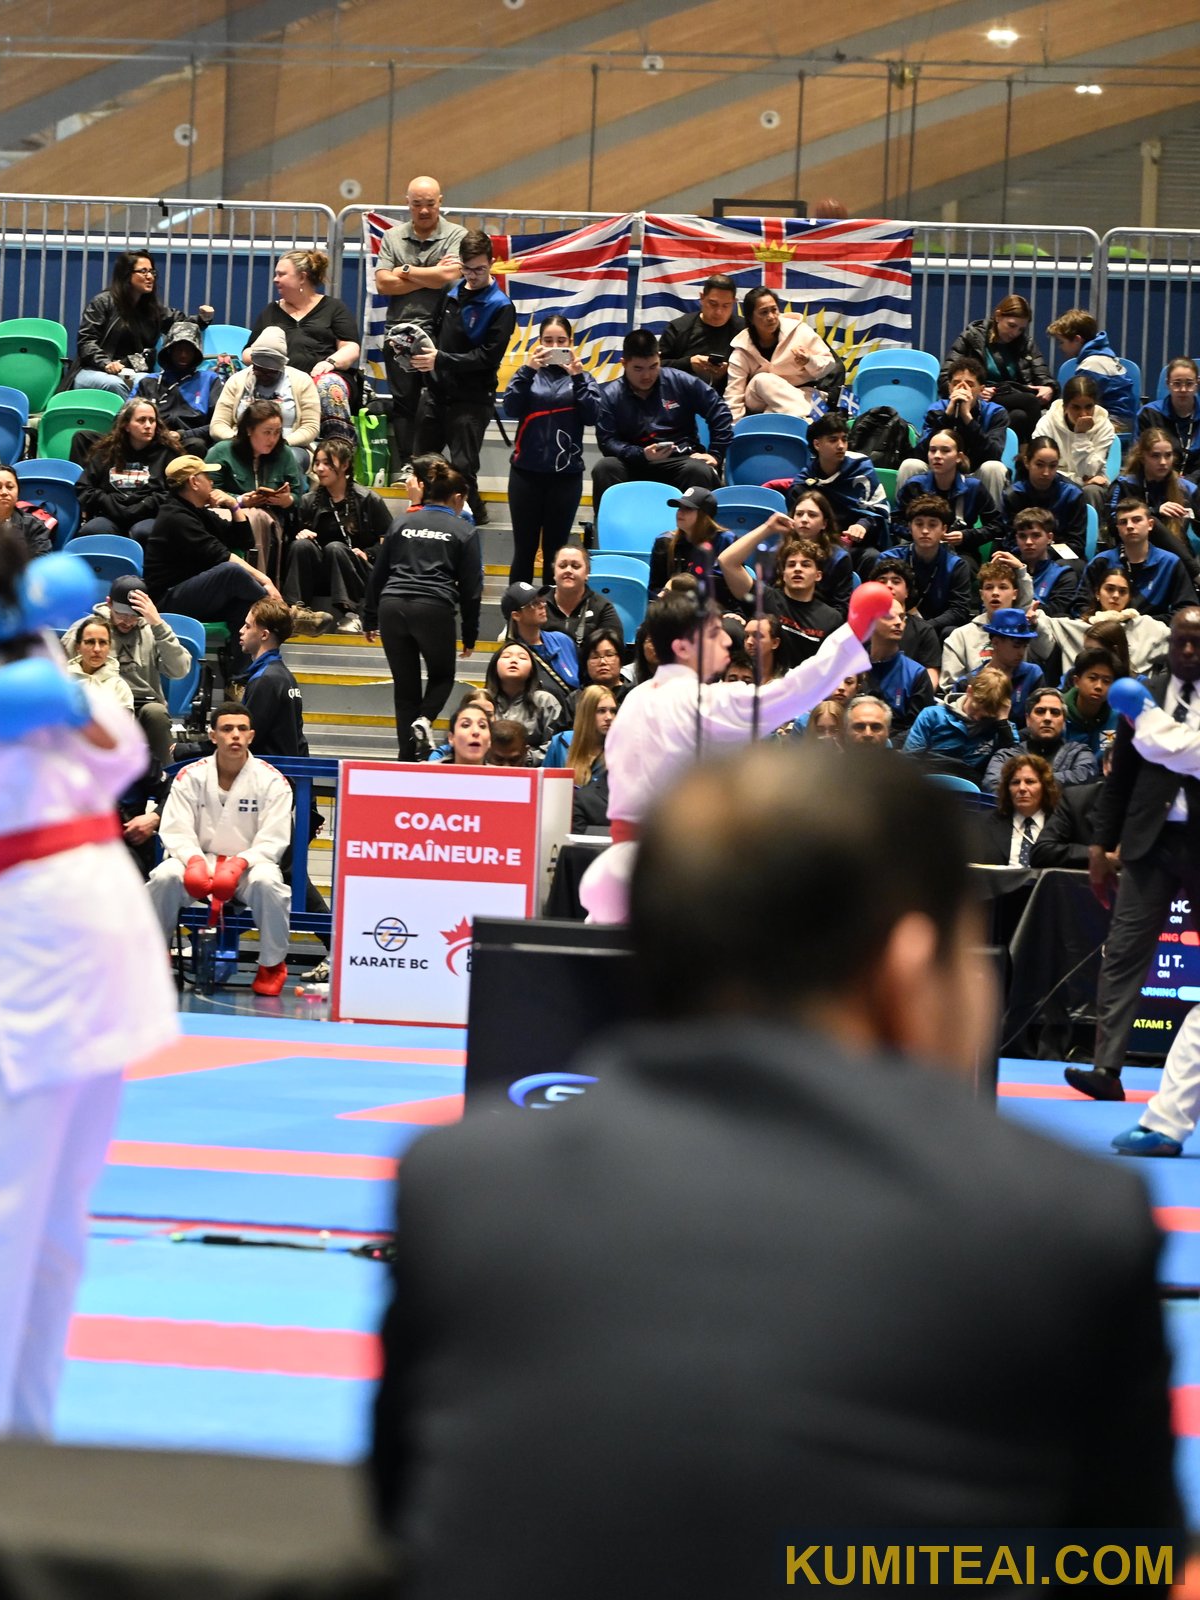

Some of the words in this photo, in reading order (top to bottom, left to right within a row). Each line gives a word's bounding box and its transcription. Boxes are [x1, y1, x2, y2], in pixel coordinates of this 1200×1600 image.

[401, 528, 452, 541] QUÉBEC
[395, 811, 481, 832] COACH
[349, 955, 406, 969] KARATE
[410, 958, 429, 970] BC
[1173, 955, 1185, 969] T.
[1133, 1018, 1164, 1030] ATAMI
